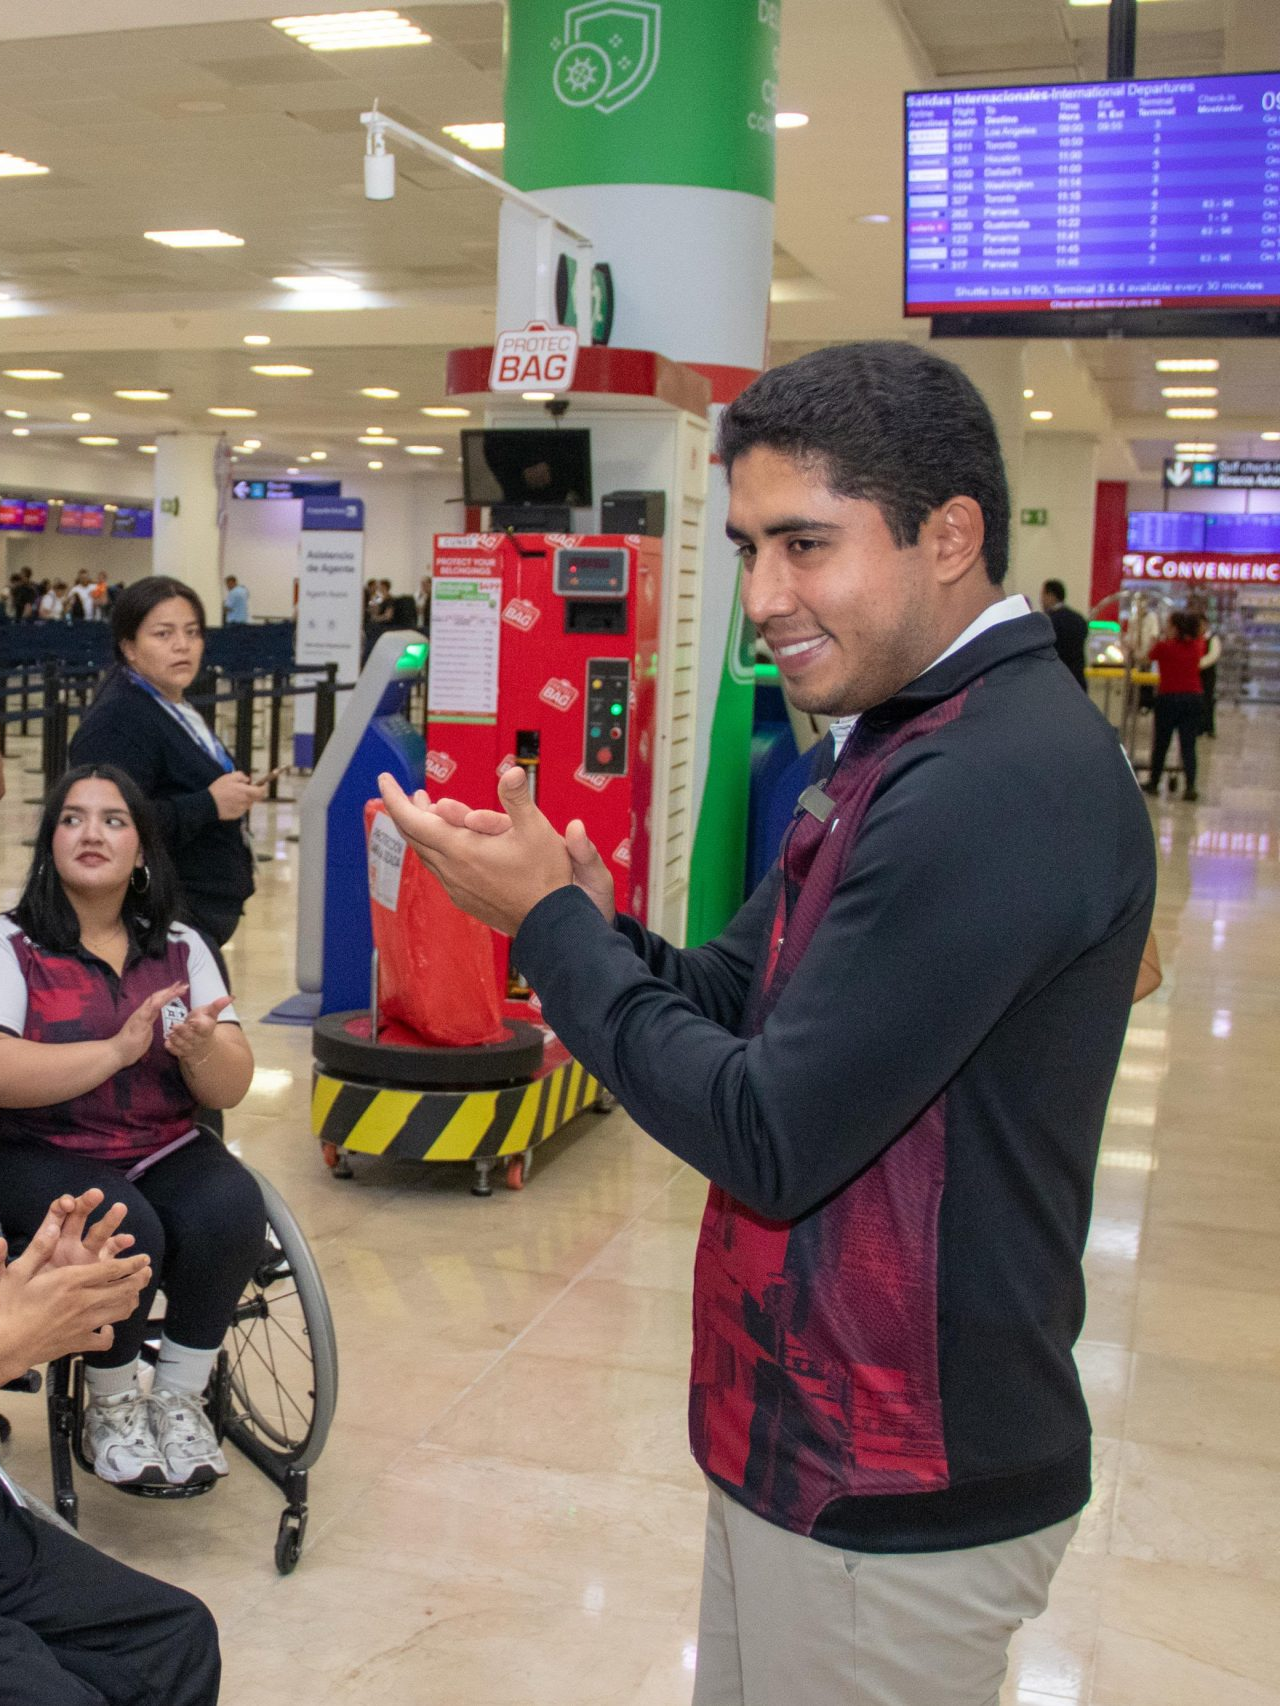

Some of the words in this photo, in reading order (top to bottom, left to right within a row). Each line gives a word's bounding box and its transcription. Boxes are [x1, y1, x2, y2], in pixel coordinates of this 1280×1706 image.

[906, 95, 951, 106] Salidas
[1128, 83, 1195, 97] Departures
[985, 116, 1019, 125] Destino
[1139, 107, 1176, 117] Terminal
[985, 140, 1018, 150] Toronto
[984, 154, 1021, 164] Houston
[984, 180, 1035, 192] Washington
[984, 194, 1017, 204] Toronto
[982, 219, 1031, 231] Guatemala
[983, 246, 1021, 257] Montreal
[955, 286, 990, 297] Shuttle
[991, 286, 1010, 296] bus
[1011, 285, 1022, 296] to
[1053, 283, 1096, 295] Terminal
[1127, 281, 1173, 293] available
[1174, 282, 1203, 292] every
[1207, 281, 1220, 291] 30
[1222, 281, 1264, 291] minutes
[502, 336, 571, 352] PROTEC
[498, 354, 567, 382] BAG
[504, 606, 533, 627] BAG
[543, 686, 571, 706] BAG
